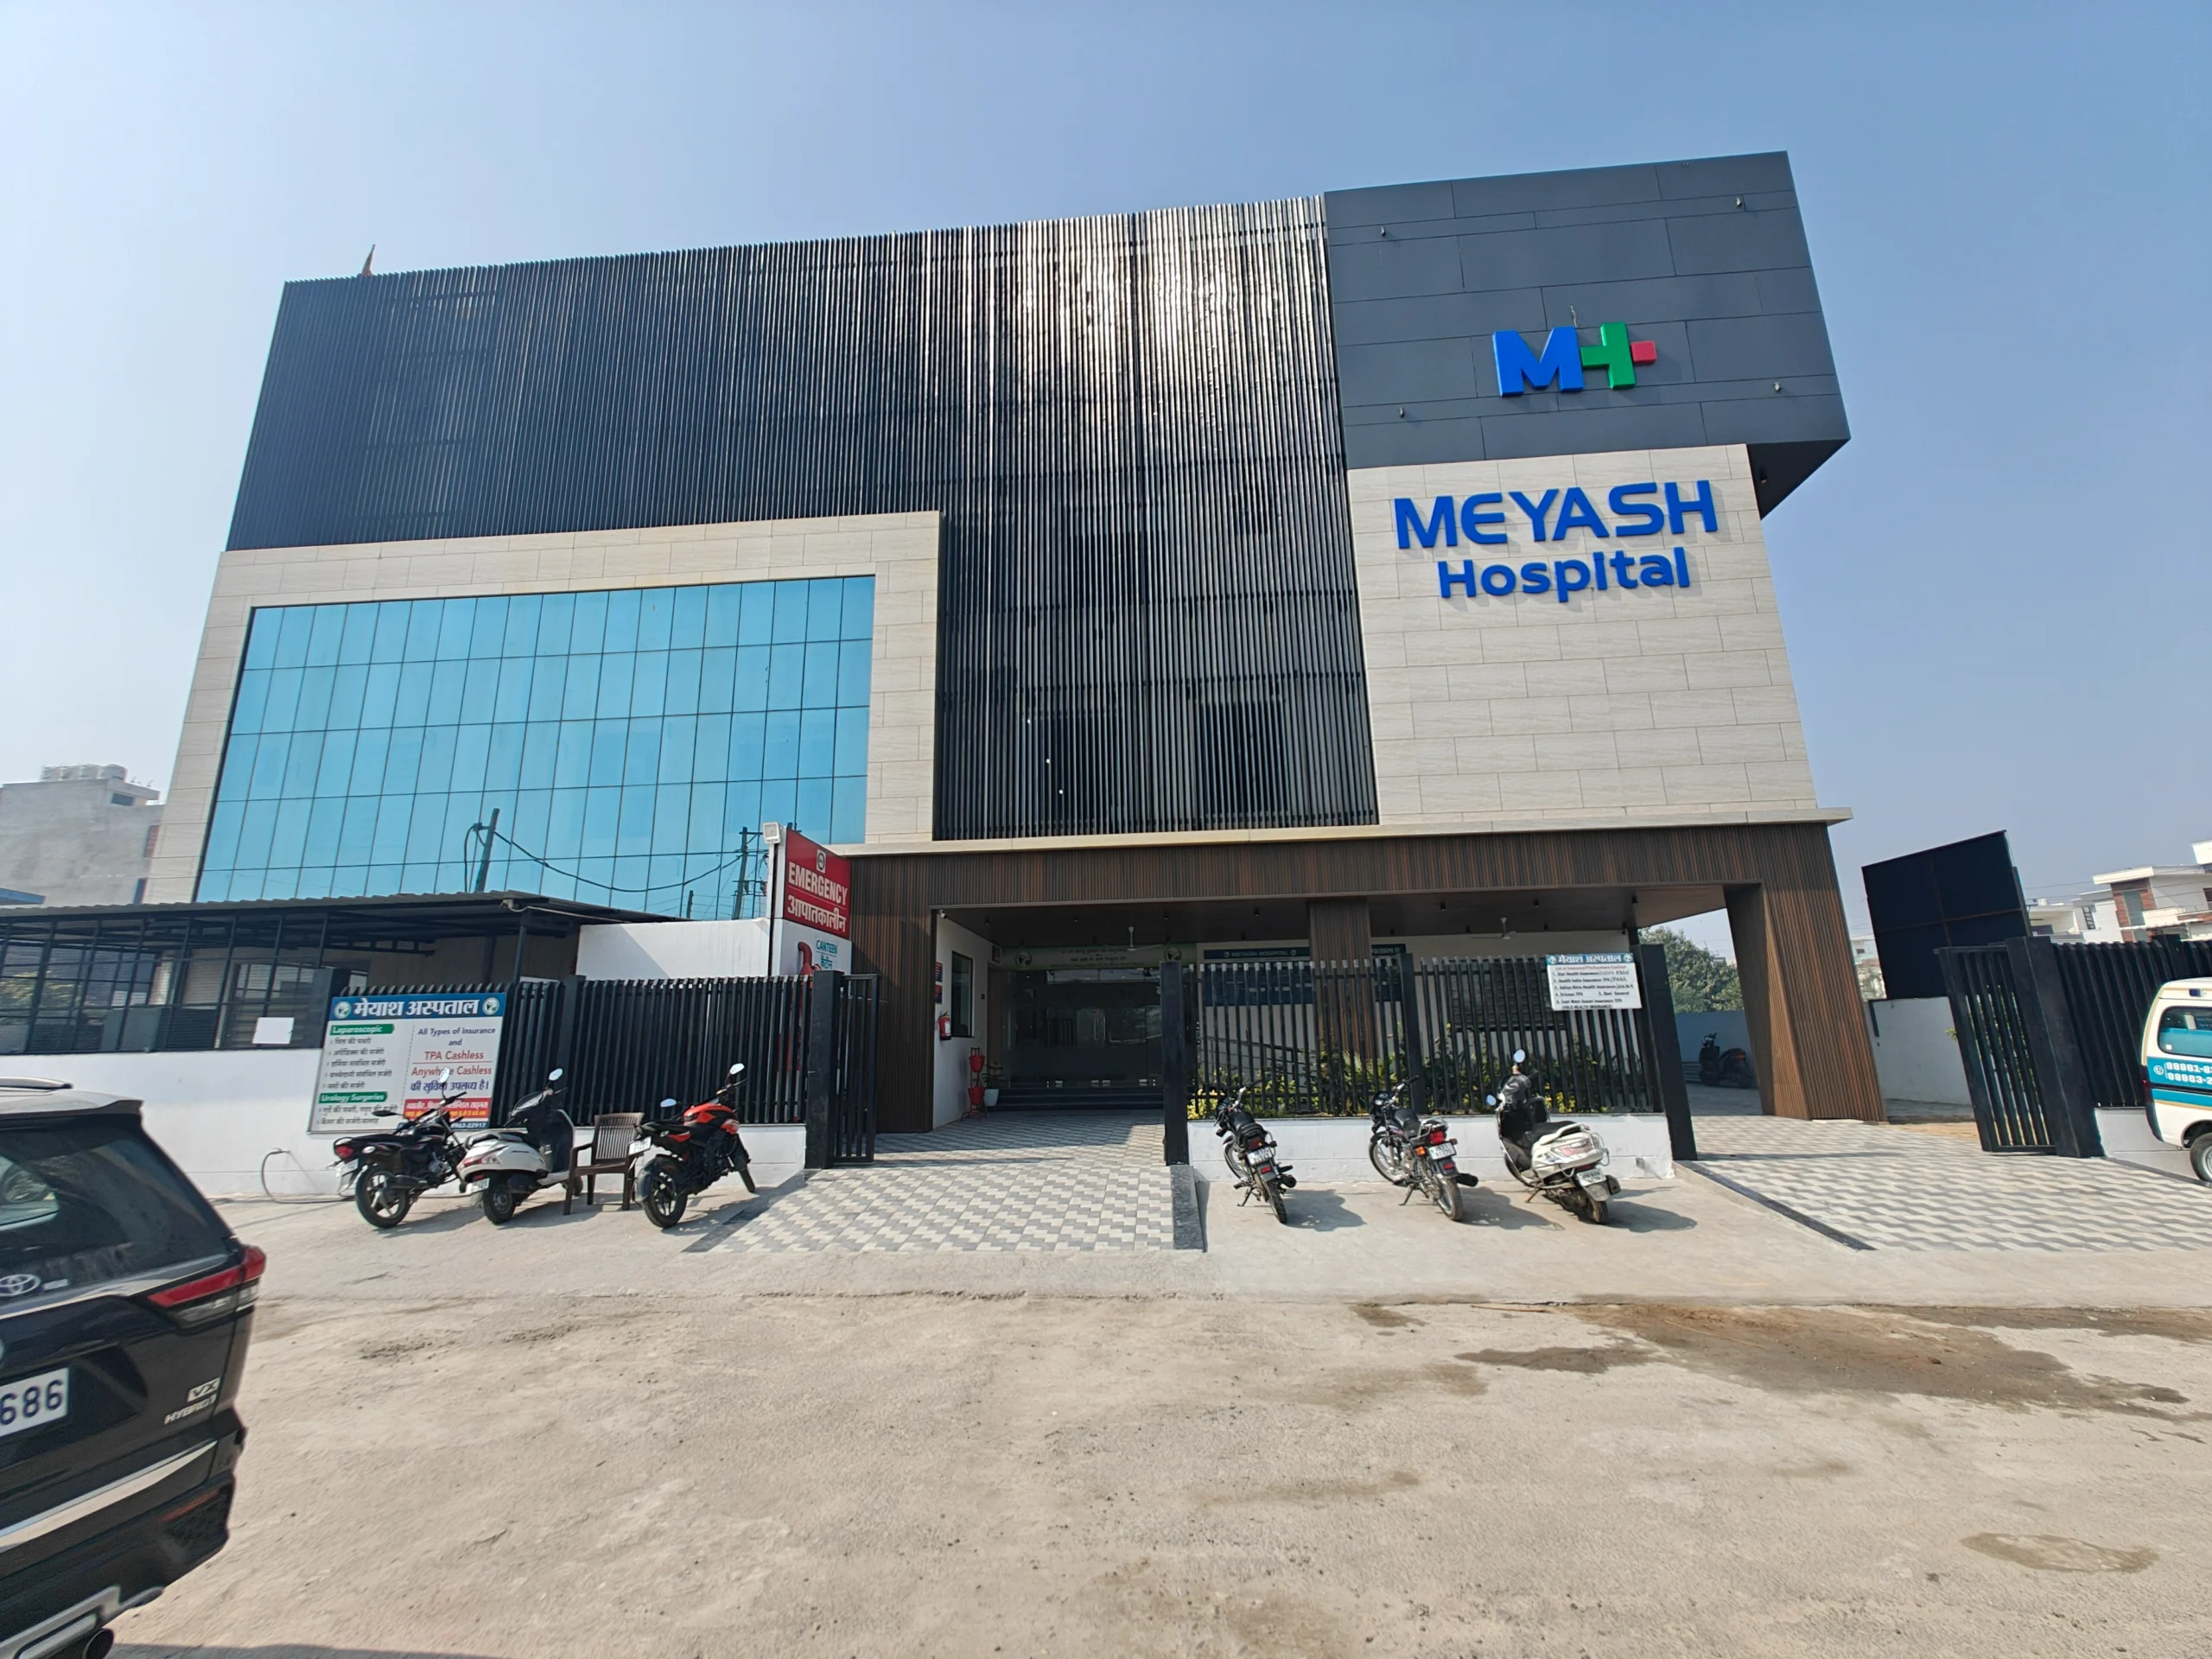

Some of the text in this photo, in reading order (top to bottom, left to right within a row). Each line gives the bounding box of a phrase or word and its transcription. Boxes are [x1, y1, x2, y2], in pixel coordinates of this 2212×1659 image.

[1394, 479, 1718, 550] MEYASH
[788, 861, 849, 906] EMERGENCY
[787, 895, 847, 932] आपातकालीन
[817, 940, 837, 954] CANTEEN
[1559, 955, 1584, 963] मेयाश
[353, 998, 480, 1017] मेयाश अस्पताल
[333, 1025, 383, 1034] Laparoscopic
[429, 1027, 450, 1036] Types
[424, 1050, 484, 1060] TPA Cashless
[411, 1065, 492, 1077] Anywhe Cashless
[410, 1080, 421, 1091] की
[450, 1082, 477, 1090] उपलब्ध
[321, 1093, 384, 1103] Urology Surgeries
[191, 1377, 219, 1398] VX
[0, 1379, 63, 1425] 686
